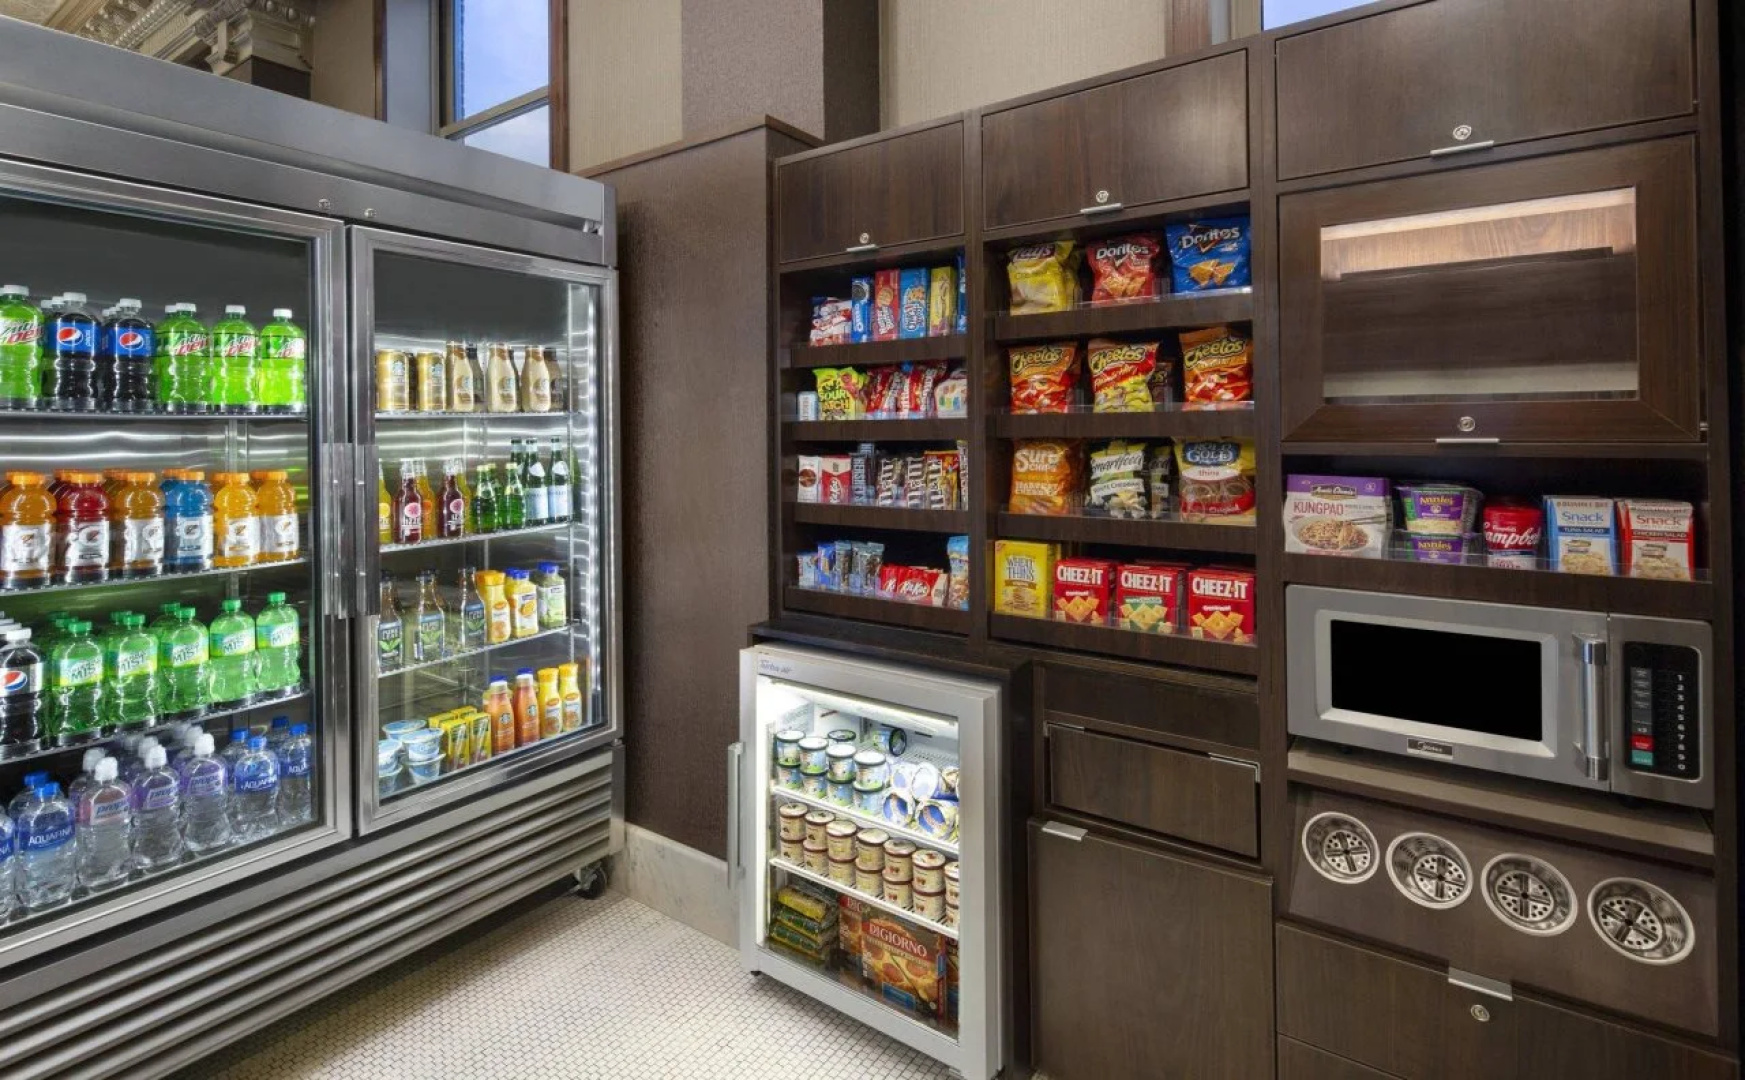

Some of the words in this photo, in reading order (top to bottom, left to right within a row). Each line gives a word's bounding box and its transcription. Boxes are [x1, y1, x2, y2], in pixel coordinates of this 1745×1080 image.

[1182, 227, 1240, 249] Doritos
[1096, 243, 1149, 259] Doritos
[1012, 348, 1063, 374] Cheetos
[1091, 347, 1145, 374] Cheetos
[1185, 339, 1244, 369] Cheetos
[1186, 449, 1233, 462] GOLD
[1562, 510, 1604, 521] Snack
[1636, 514, 1682, 526] Snack
